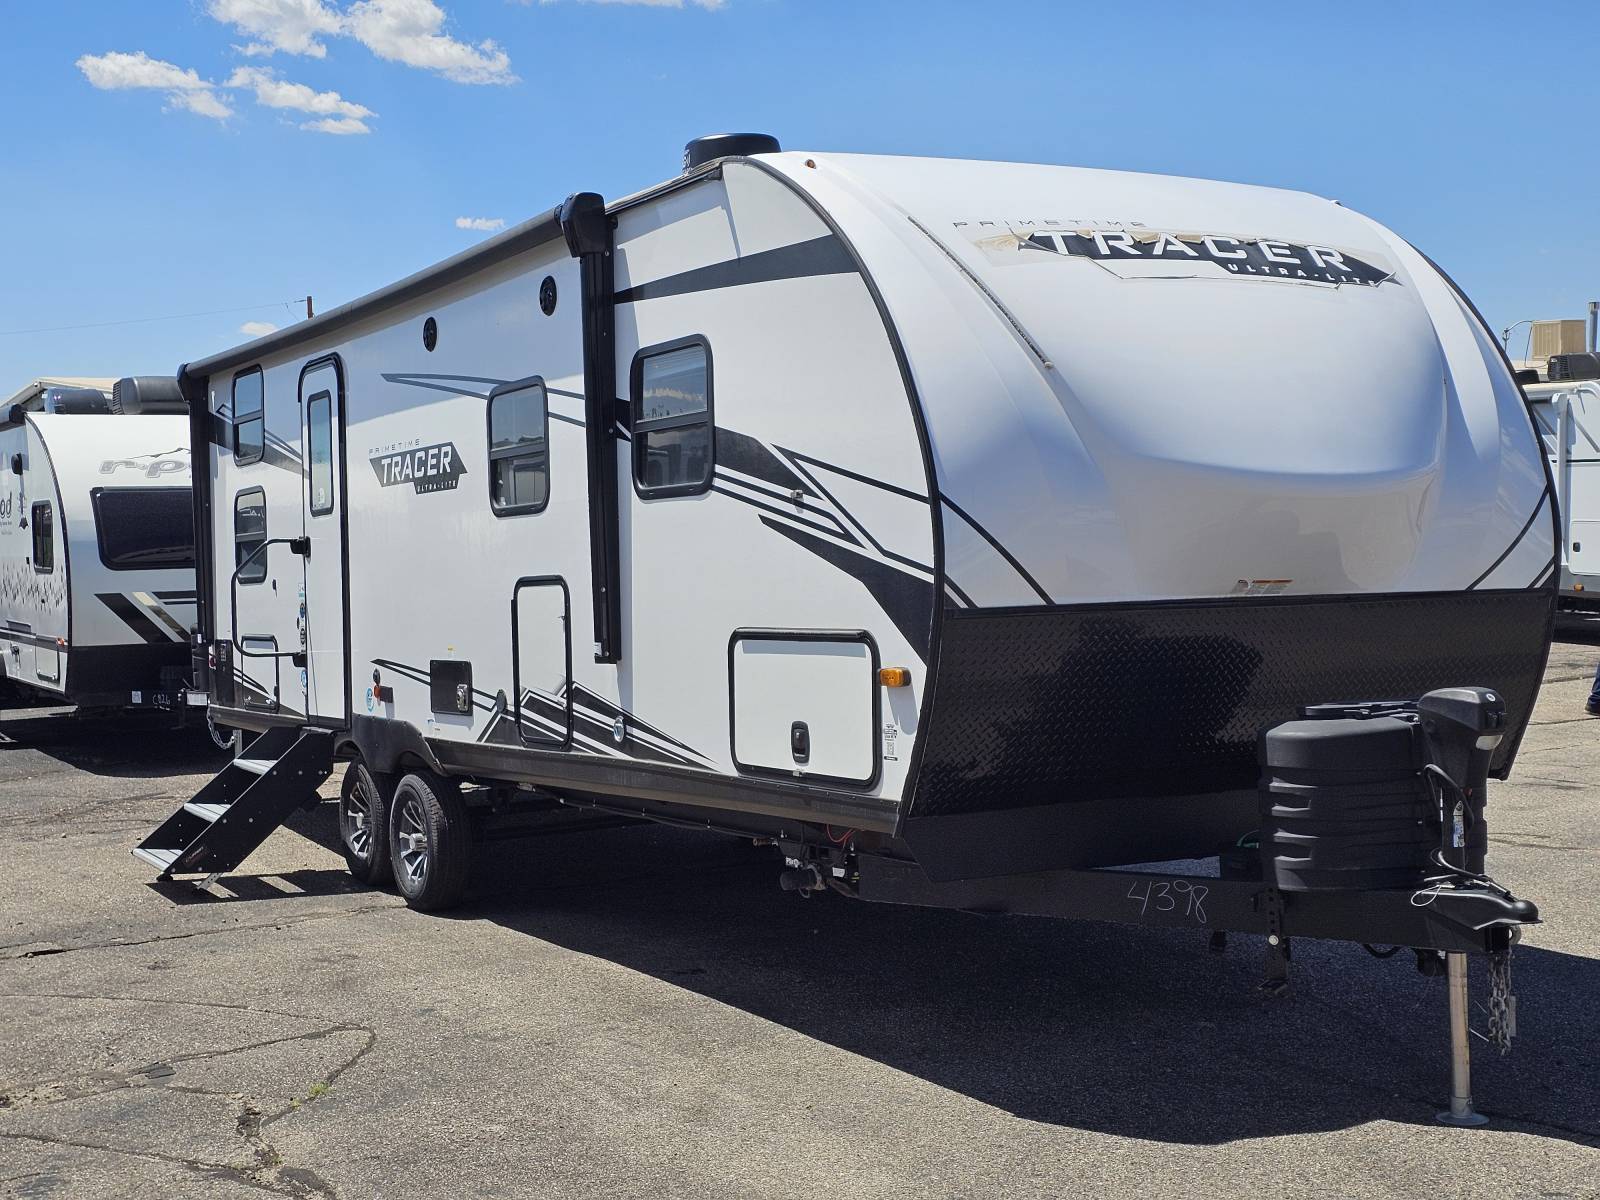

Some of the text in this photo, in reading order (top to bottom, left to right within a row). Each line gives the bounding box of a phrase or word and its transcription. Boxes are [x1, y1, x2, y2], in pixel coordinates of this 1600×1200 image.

[1032, 230, 1353, 272] TRACER
[1227, 263, 1376, 287] ULTRA-LITE
[381, 445, 452, 484] TRACER
[1127, 879, 1209, 924] 4398
